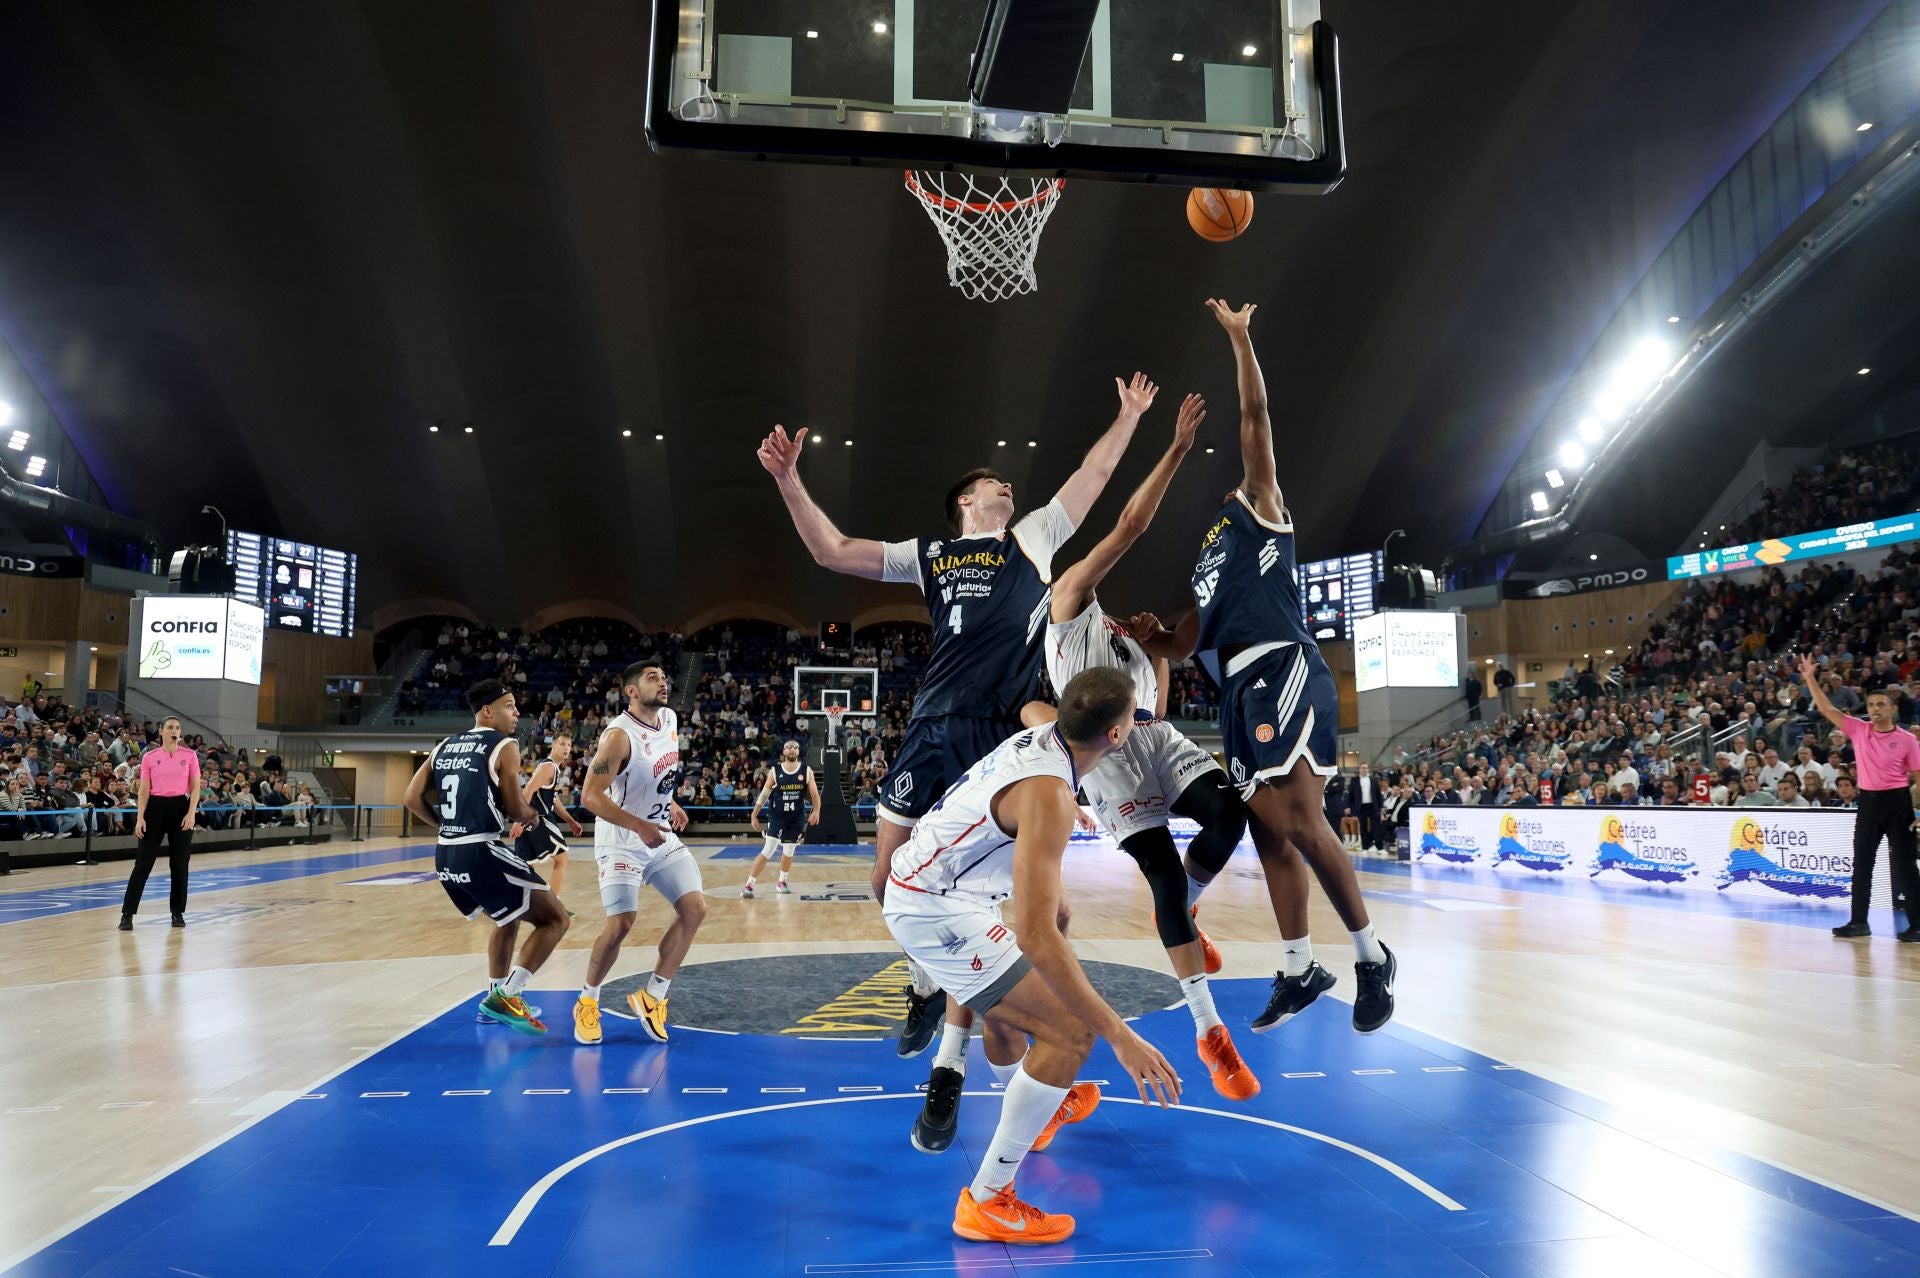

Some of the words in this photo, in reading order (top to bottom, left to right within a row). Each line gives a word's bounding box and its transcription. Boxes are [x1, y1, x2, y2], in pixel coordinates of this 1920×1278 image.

[1836, 521, 1875, 536] OVIEDO
[932, 551, 1006, 577] ALIMERKA
[946, 568, 990, 580] OVIEDO
[956, 581, 992, 593] Asturias
[948, 604, 963, 635] 4
[178, 647, 211, 655] confia.es
[1696, 779, 1709, 797] 5
[440, 774, 460, 820] 3
[647, 803, 672, 820] 25
[784, 801, 795, 812] 24
[1428, 815, 1458, 831] Cetárea
[1506, 817, 1543, 834] Cetárea
[1608, 820, 1657, 839] Cetárea
[1442, 830, 1476, 847] Tazones
[1524, 834, 1566, 853] Tazones
[1742, 823, 1808, 847] Cetárea
[1633, 839, 1688, 861] Tazones
[1776, 846, 1852, 873] Tazones
